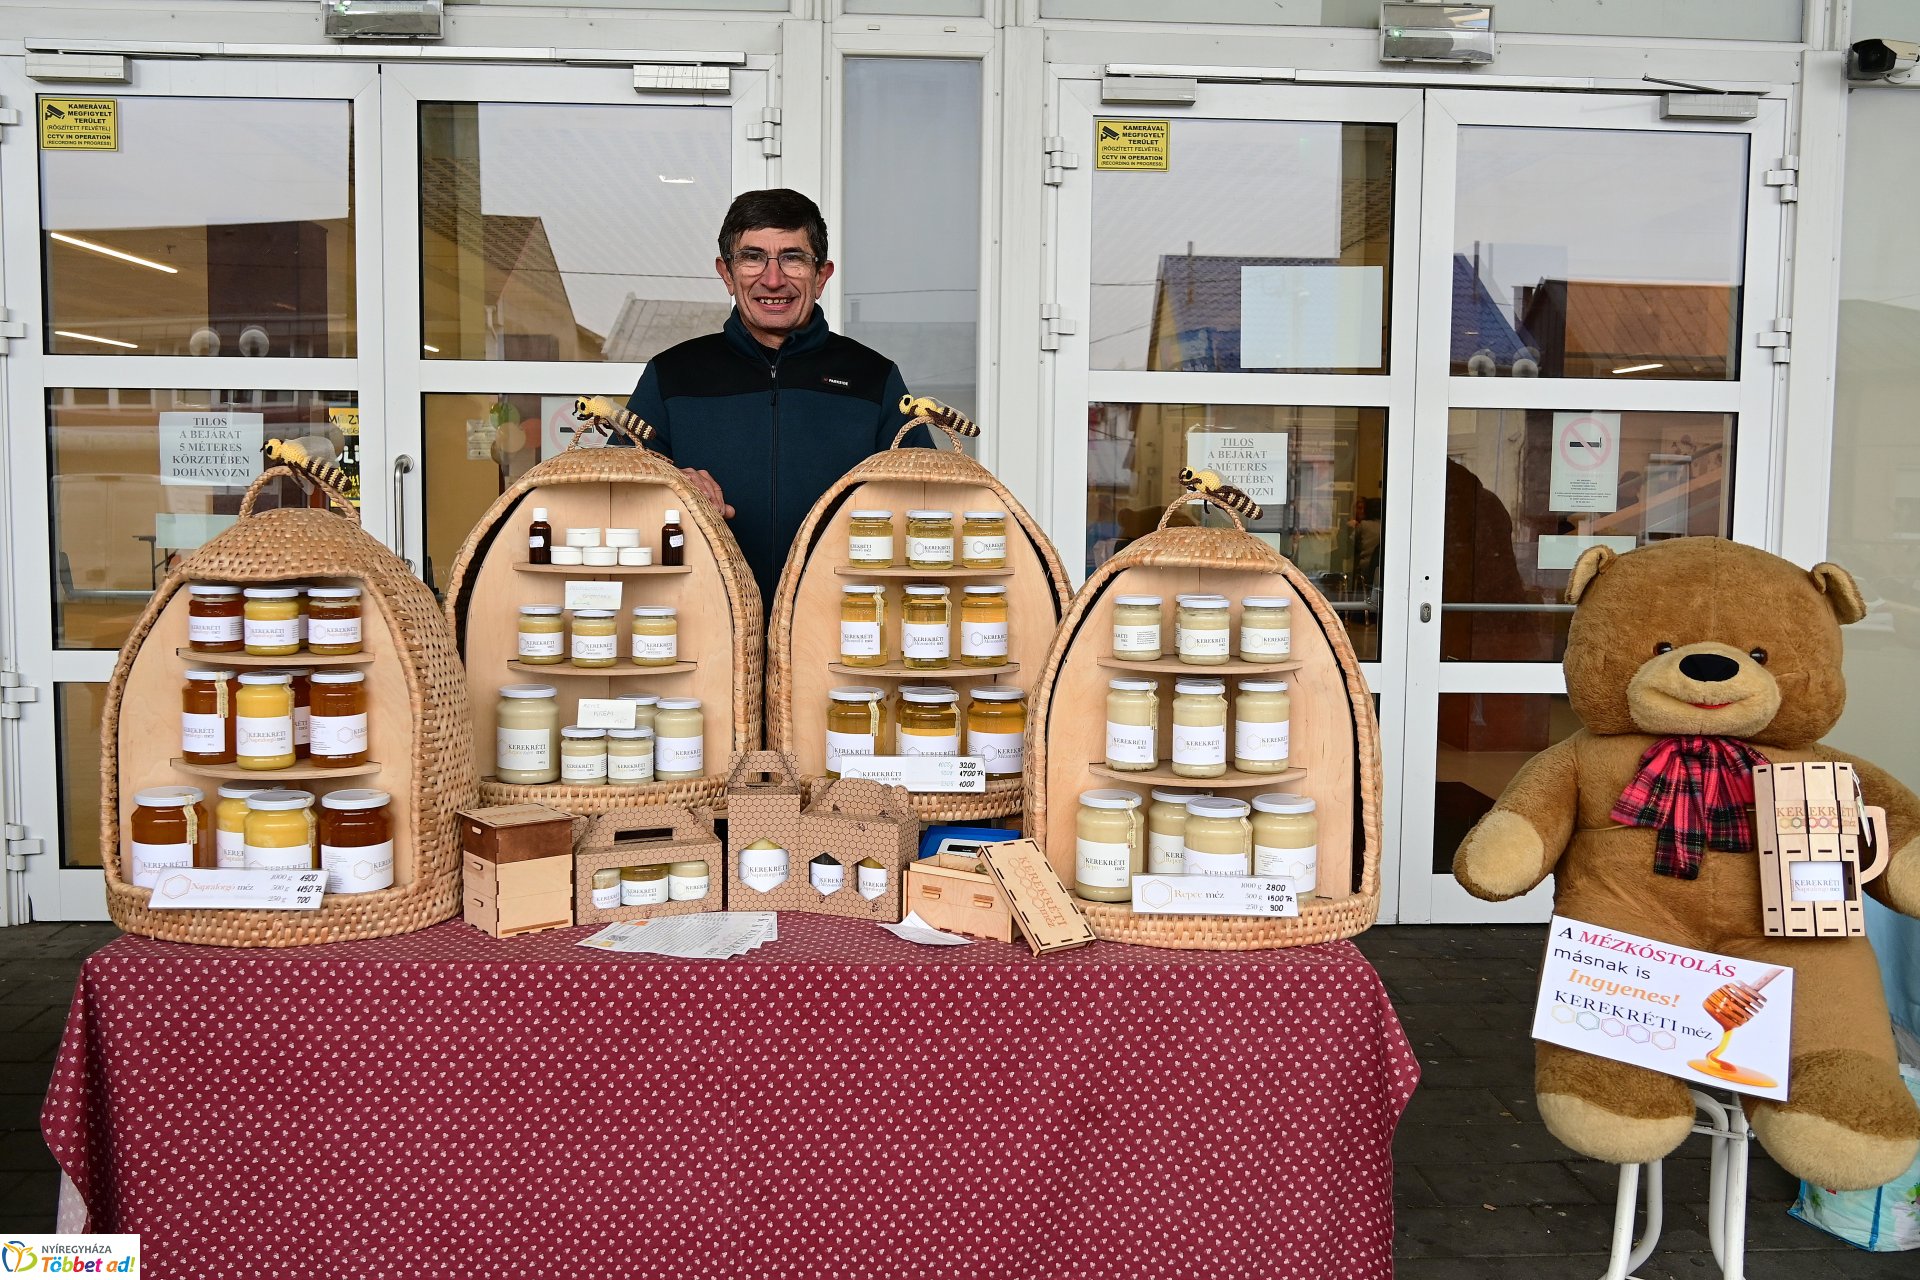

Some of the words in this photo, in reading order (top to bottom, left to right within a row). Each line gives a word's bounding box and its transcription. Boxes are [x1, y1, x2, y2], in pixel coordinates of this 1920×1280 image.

[193, 417, 228, 426] TILOS
[179, 430, 187, 439] A
[190, 428, 242, 439] BEJÁRAT
[179, 442, 186, 452] 5
[188, 441, 242, 452] MÉTERES
[1221, 437, 1254, 447] TILOS
[172, 453, 250, 465] KÖRZETÉBEN
[1207, 450, 1215, 459] A
[1218, 448, 1268, 459] BEJÁRAT
[172, 465, 250, 477] DOHÁNYOZNI
[1207, 462, 1213, 471] 5
[1215, 460, 1267, 472] MÉTERES
[959, 761, 977, 770] 3200
[959, 780, 975, 788] 1000
[1776, 804, 1854, 817] KEREKRÉTI
[1085, 857, 1125, 867] KEREKRÉTI
[749, 864, 788, 873] KEREKRÉTI
[237, 883, 254, 891] méz
[1265, 883, 1286, 892] 2800
[1794, 877, 1840, 887] KEREKRÉTI
[1018, 856, 1068, 926] KEREKRÉTI
[1174, 888, 1203, 900] Repce
[1205, 890, 1225, 899] méz
[296, 895, 311, 904] 700
[1267, 894, 1284, 902] 1500
[1269, 904, 1284, 912] 900
[1040, 908, 1056, 929] méz
[1558, 926, 1573, 940] A
[1578, 929, 1737, 978] MÉZKÓSTOLÁS
[1554, 947, 1630, 975] másnak
[1636, 965, 1651, 980] is
[1567, 967, 1682, 1009] Ingyenes!
[1554, 989, 1677, 1032] KEREKRÉTI
[1681, 1024, 1713, 1041] méz
